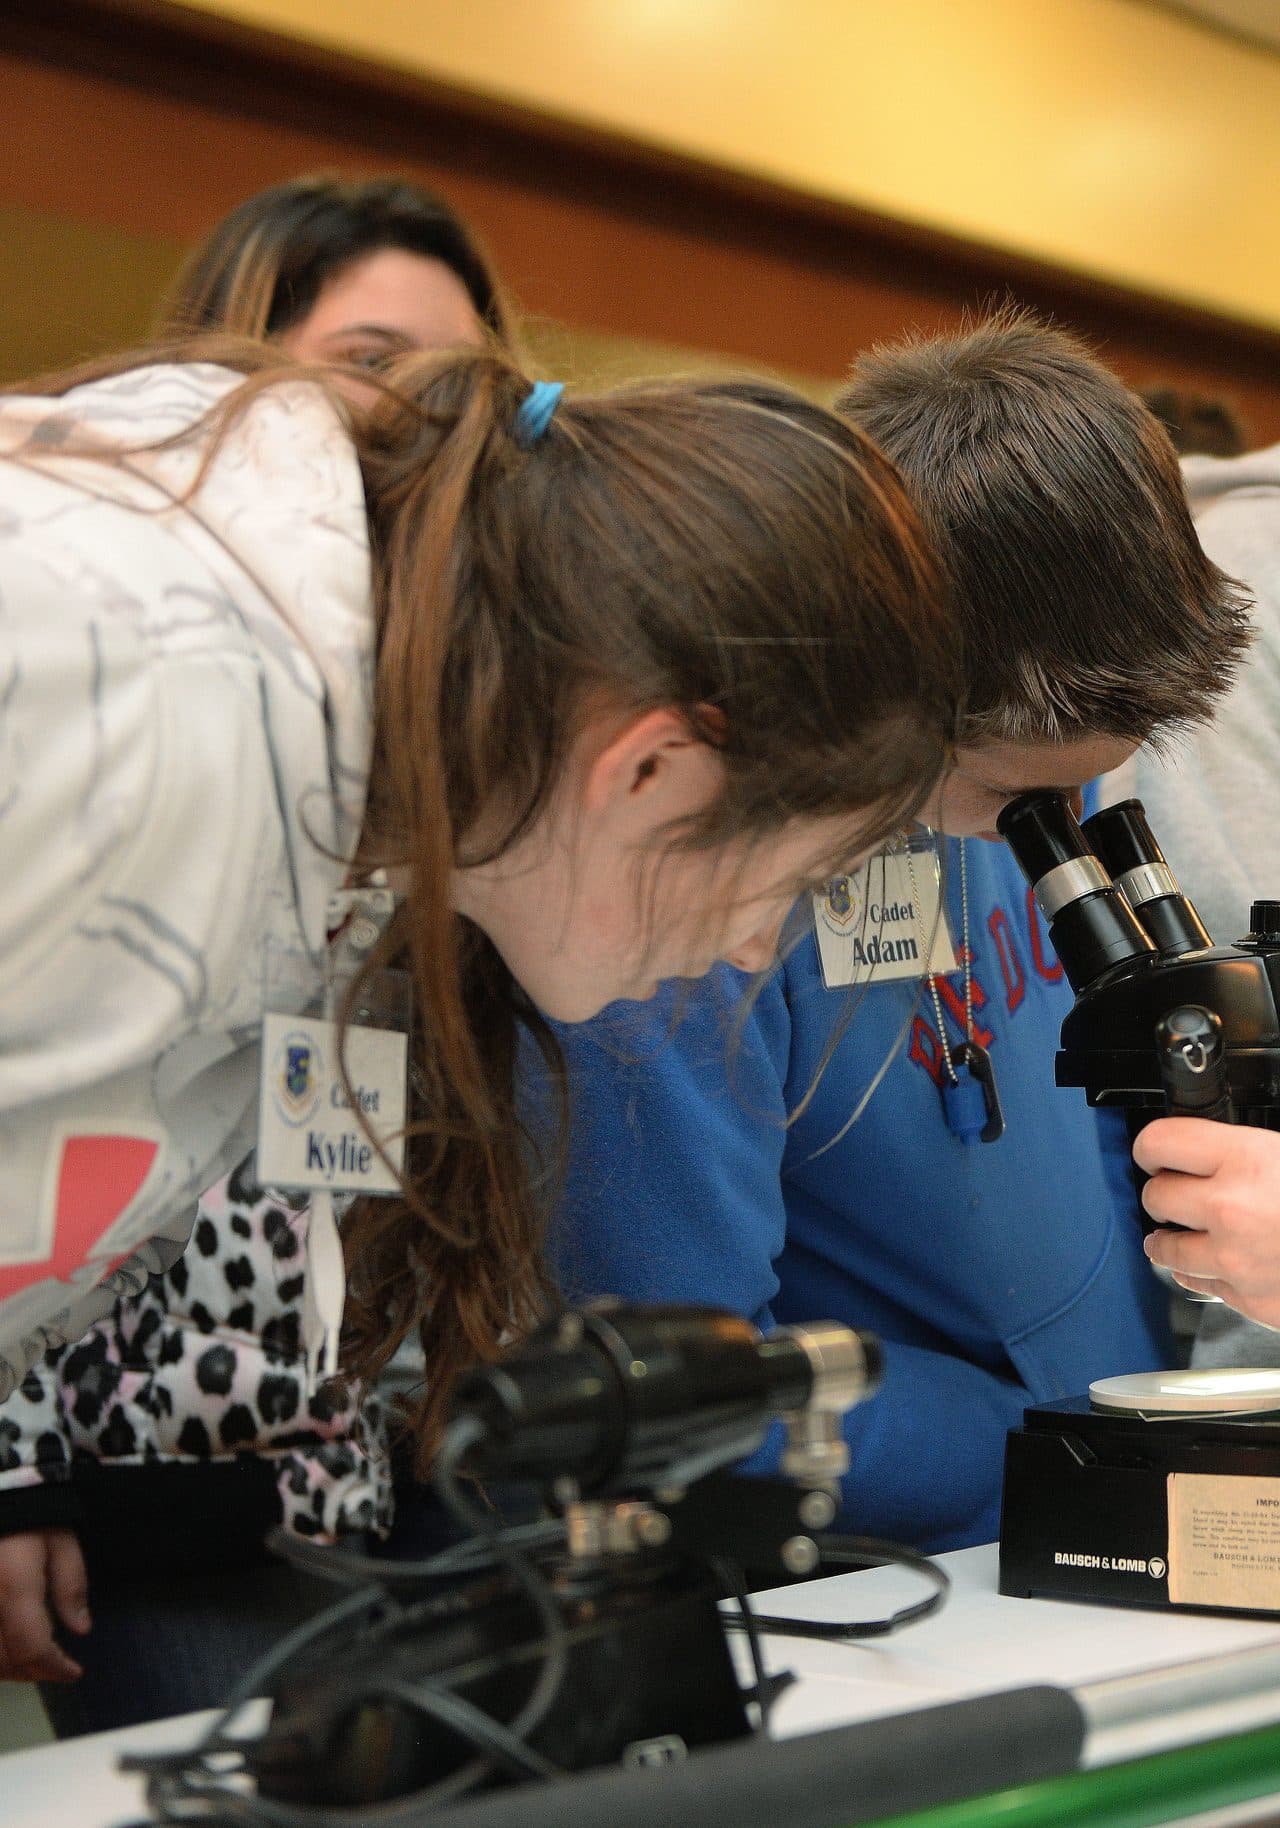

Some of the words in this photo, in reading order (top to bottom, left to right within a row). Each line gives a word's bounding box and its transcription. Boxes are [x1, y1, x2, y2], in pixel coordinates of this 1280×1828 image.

[870, 902, 915, 924] Cadet
[853, 935, 919, 967] Adam
[306, 1133, 372, 1180] Kylie
[1054, 1552, 1100, 1568] BAUSCH
[1101, 1557, 1110, 1569] &
[1111, 1558, 1147, 1573] LOMB
[1213, 1552, 1248, 1562] BAUSCH
